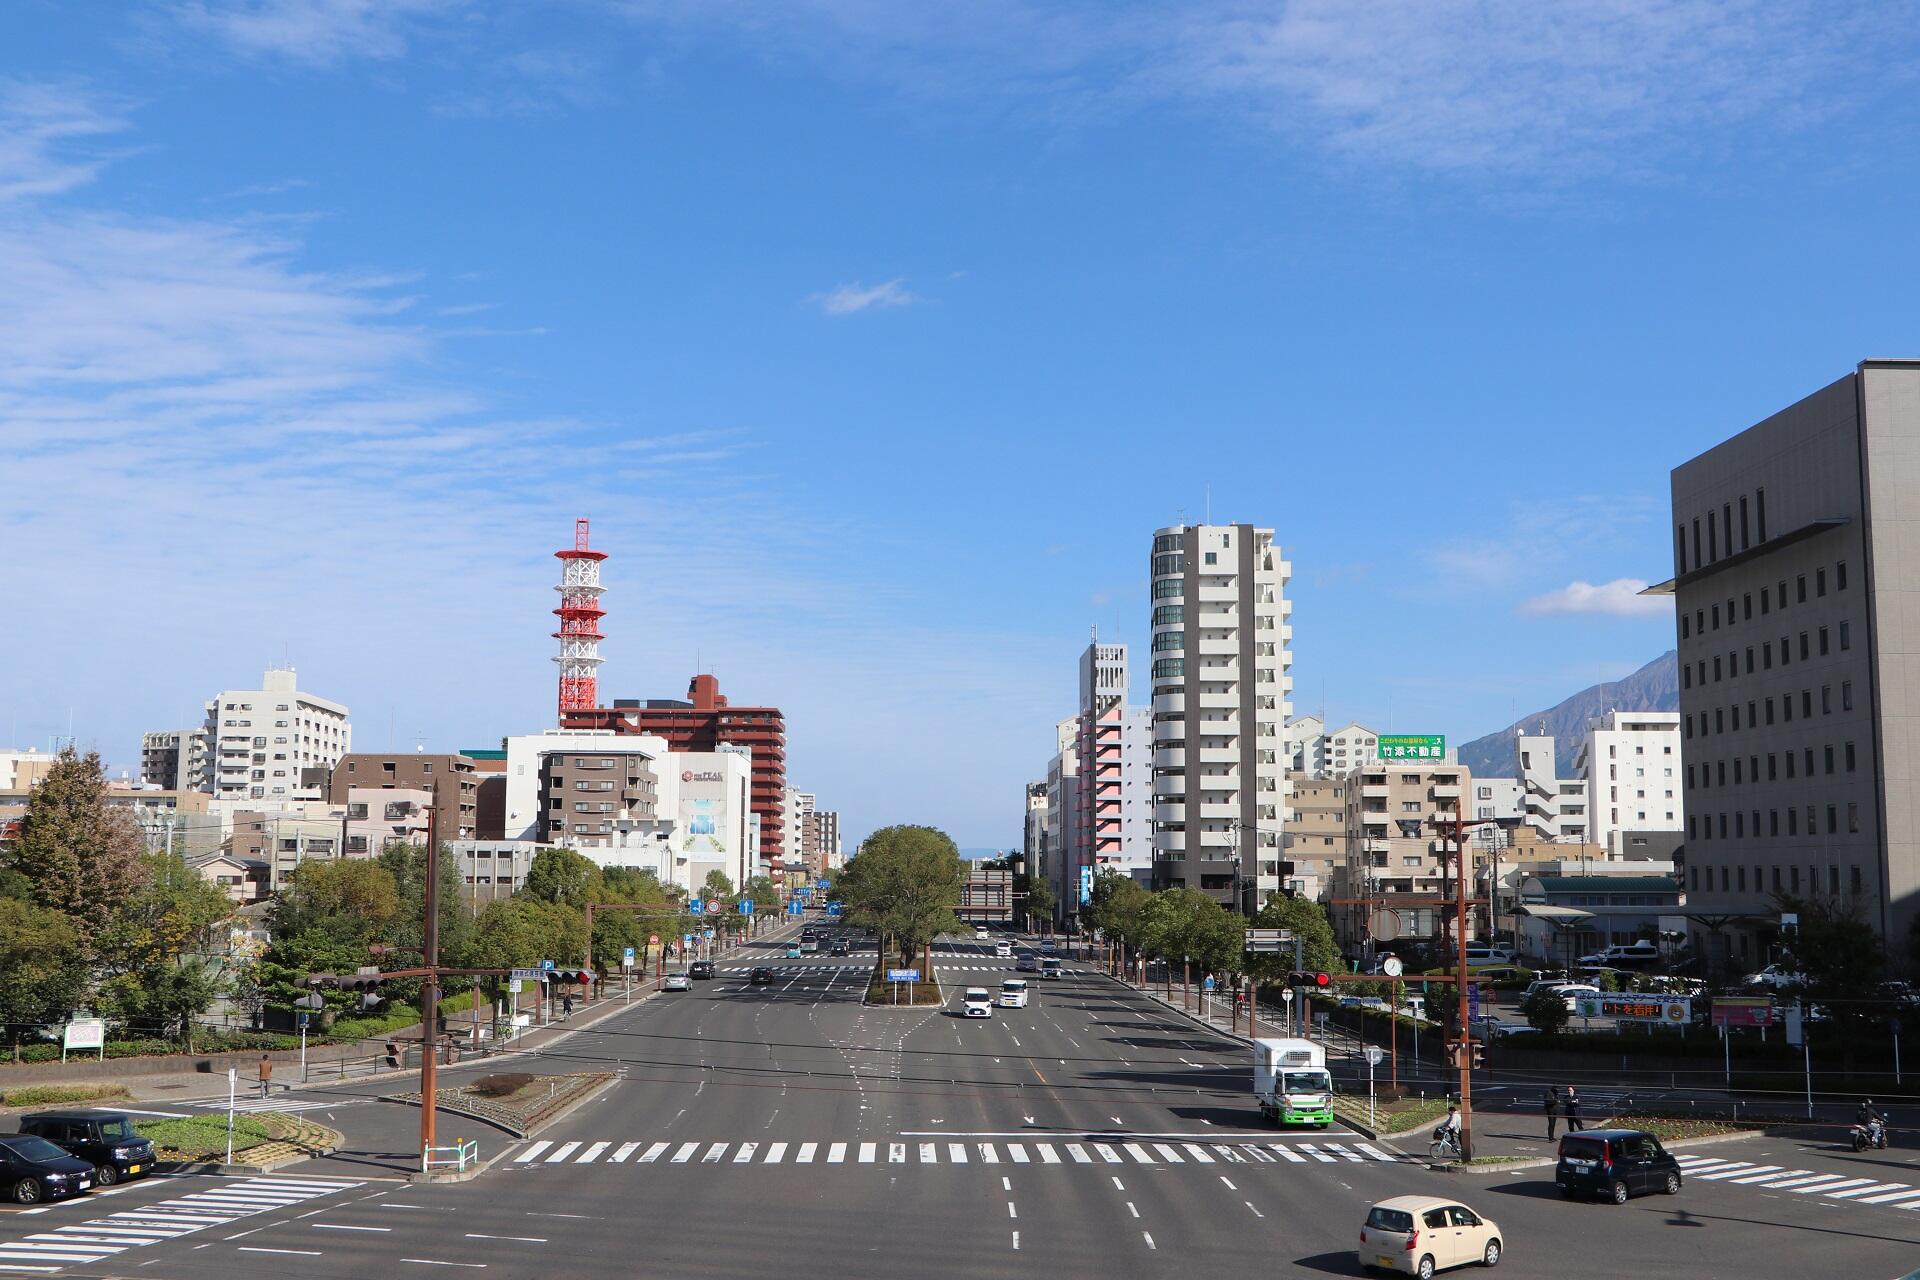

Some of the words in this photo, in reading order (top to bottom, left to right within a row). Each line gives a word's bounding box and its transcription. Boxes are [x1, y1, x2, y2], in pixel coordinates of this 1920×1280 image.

[1382, 745, 1441, 757] 竹添不動産
